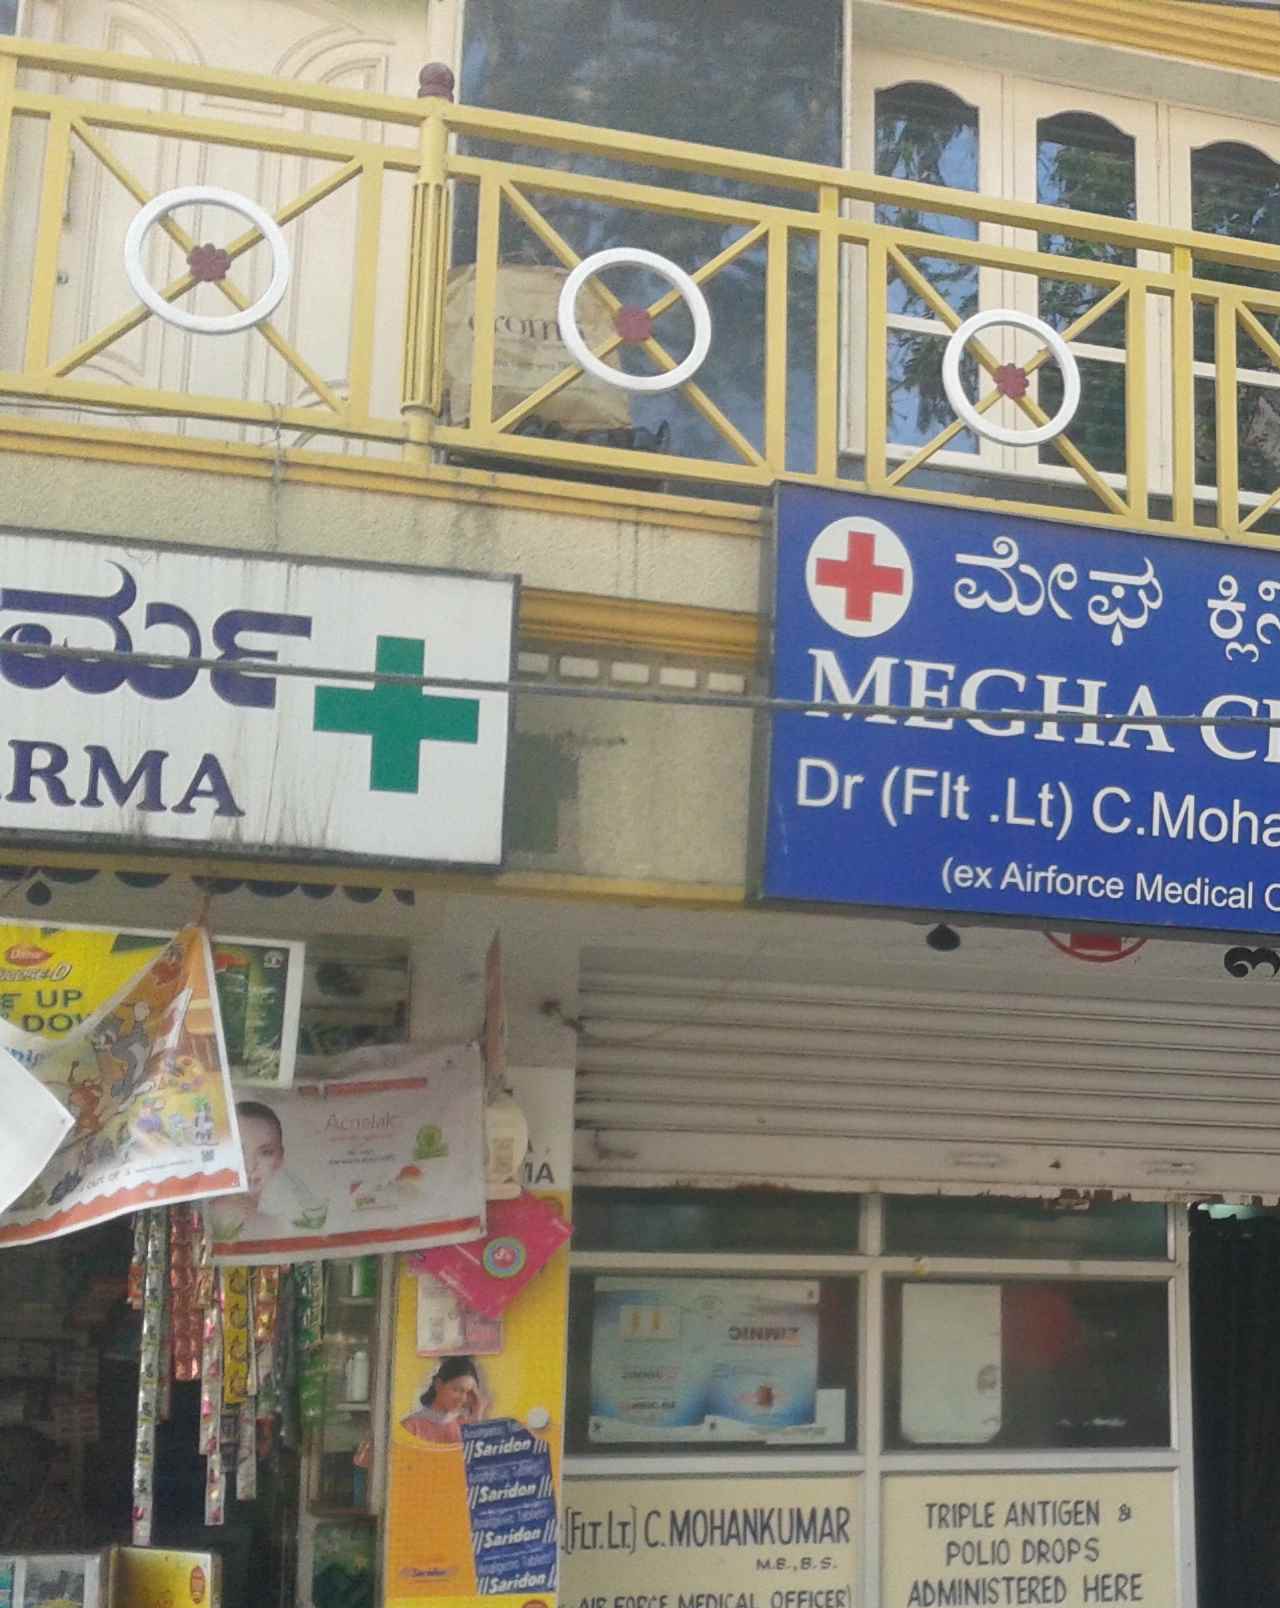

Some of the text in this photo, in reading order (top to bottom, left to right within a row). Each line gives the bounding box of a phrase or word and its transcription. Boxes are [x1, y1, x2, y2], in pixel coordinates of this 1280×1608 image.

[954, 535, 1164, 647] ಮೇಘ
[804, 648, 1176, 753] MEGHA
[5, 738, 246, 818] RMA
[796, 757, 865, 810] Dr
[881, 766, 970, 827] (Flt
[942, 856, 993, 894] (ex
[999, 861, 1125, 899] Airforce
[1135, 872, 1254, 910] Medical
[36, 990, 83, 1008] UP
[473, 1435, 532, 1458] Saridon
[479, 1480, 537, 1504] Saridon
[925, 1502, 997, 1529] TRIPLE
[1004, 1500, 1102, 1527] ANTIGEN
[484, 1525, 542, 1549] Saridon
[945, 1537, 1101, 1567] POLIO DROPS
[489, 1570, 547, 1594] Saridon
[907, 1572, 1146, 1608] ADMINISTERED HERE
